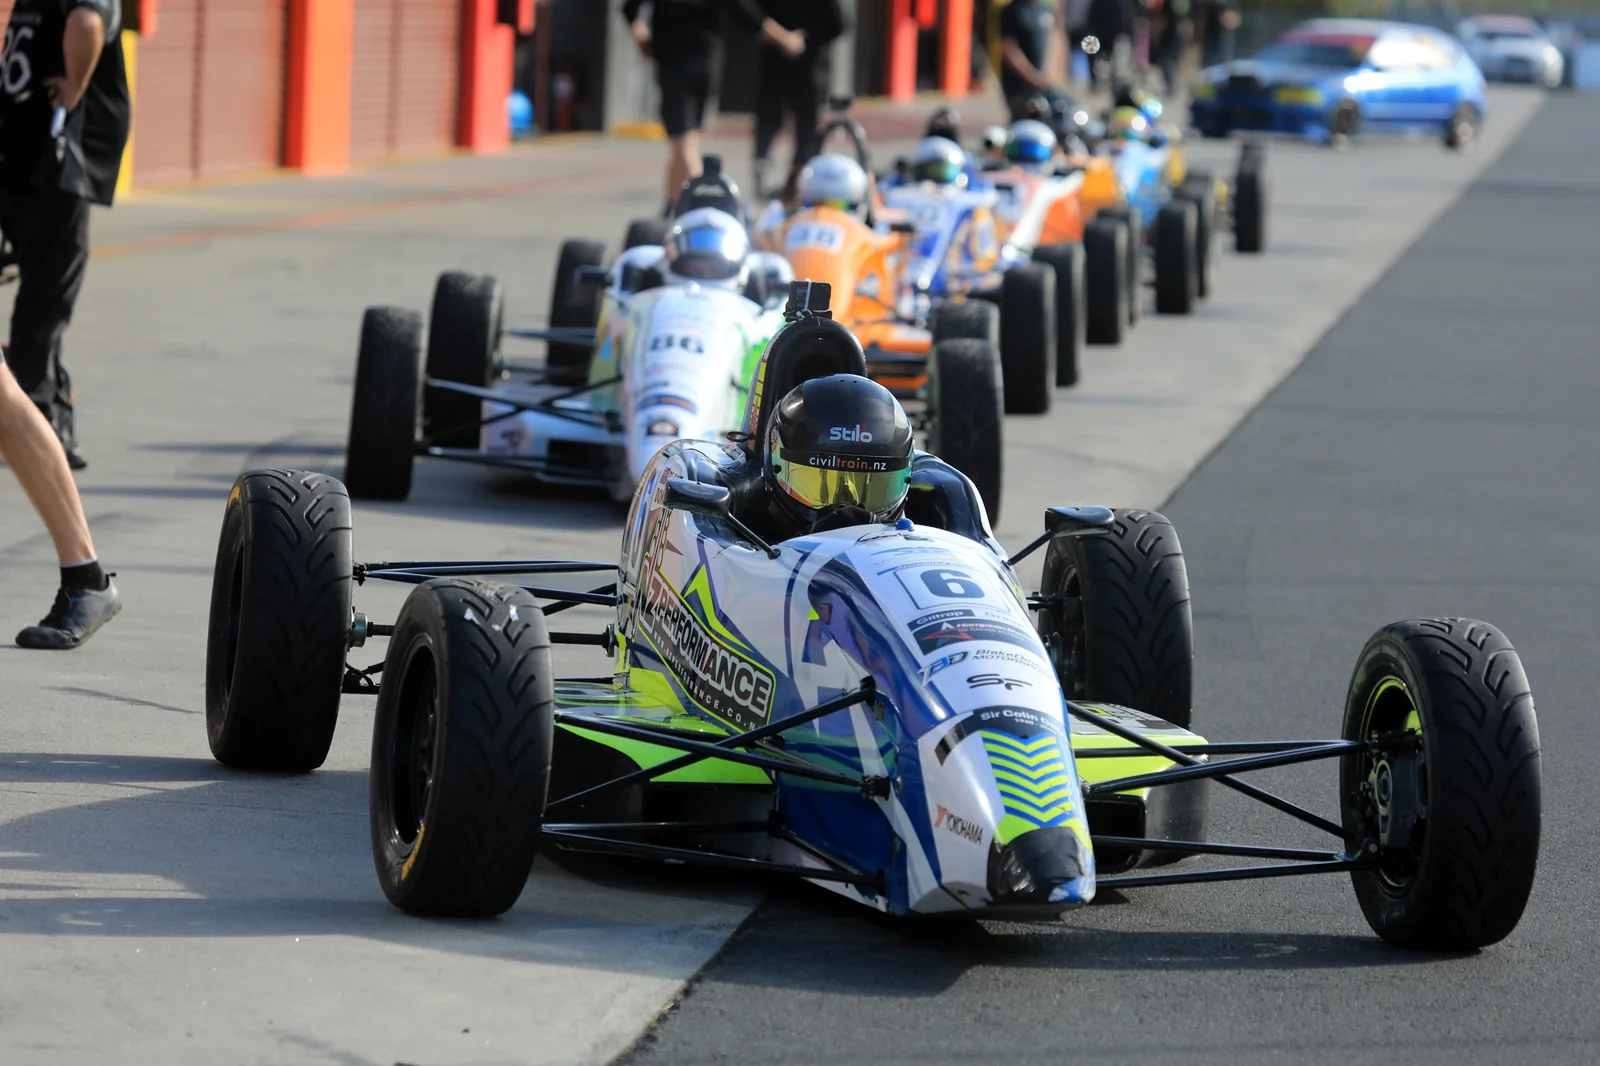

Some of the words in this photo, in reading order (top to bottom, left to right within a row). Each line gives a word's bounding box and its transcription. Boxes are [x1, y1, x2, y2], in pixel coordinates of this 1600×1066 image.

[829, 424, 873, 443] Stilo
[809, 454, 887, 471] civiltrain.nz
[920, 568, 985, 599] 6
[916, 610, 964, 627] Giltrap
[980, 710, 1001, 721] Sir
[1002, 709, 1040, 722] Colin
[947, 812, 983, 845] YOKOHAMA
